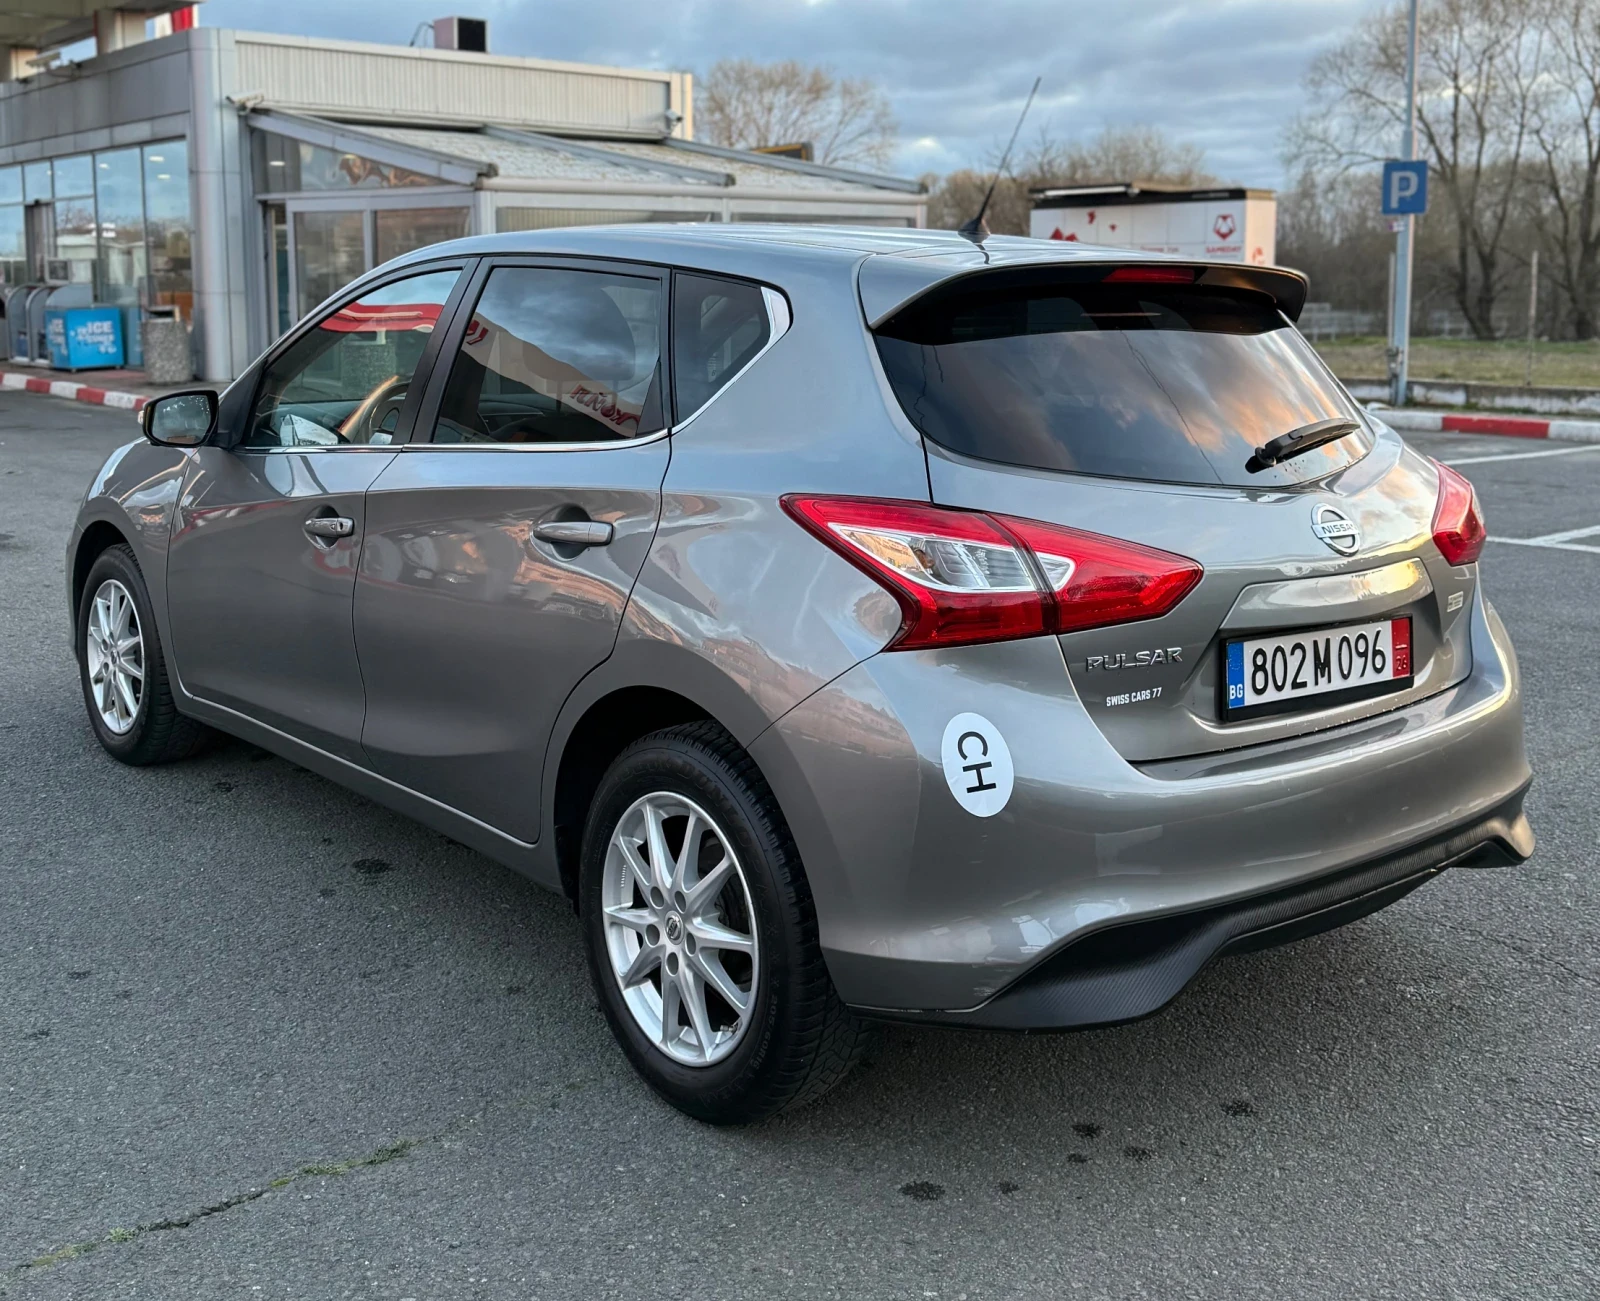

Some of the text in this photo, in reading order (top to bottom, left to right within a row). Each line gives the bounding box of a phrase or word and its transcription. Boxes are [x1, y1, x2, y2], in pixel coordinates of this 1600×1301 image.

[1391, 171, 1419, 209] P
[87, 320, 113, 334] ICE
[1086, 647, 1182, 672] PULSAR
[1106, 687, 1163, 707] SWISS CARS 77
[1229, 684, 1243, 700] BG
[958, 731, 997, 793] CH
